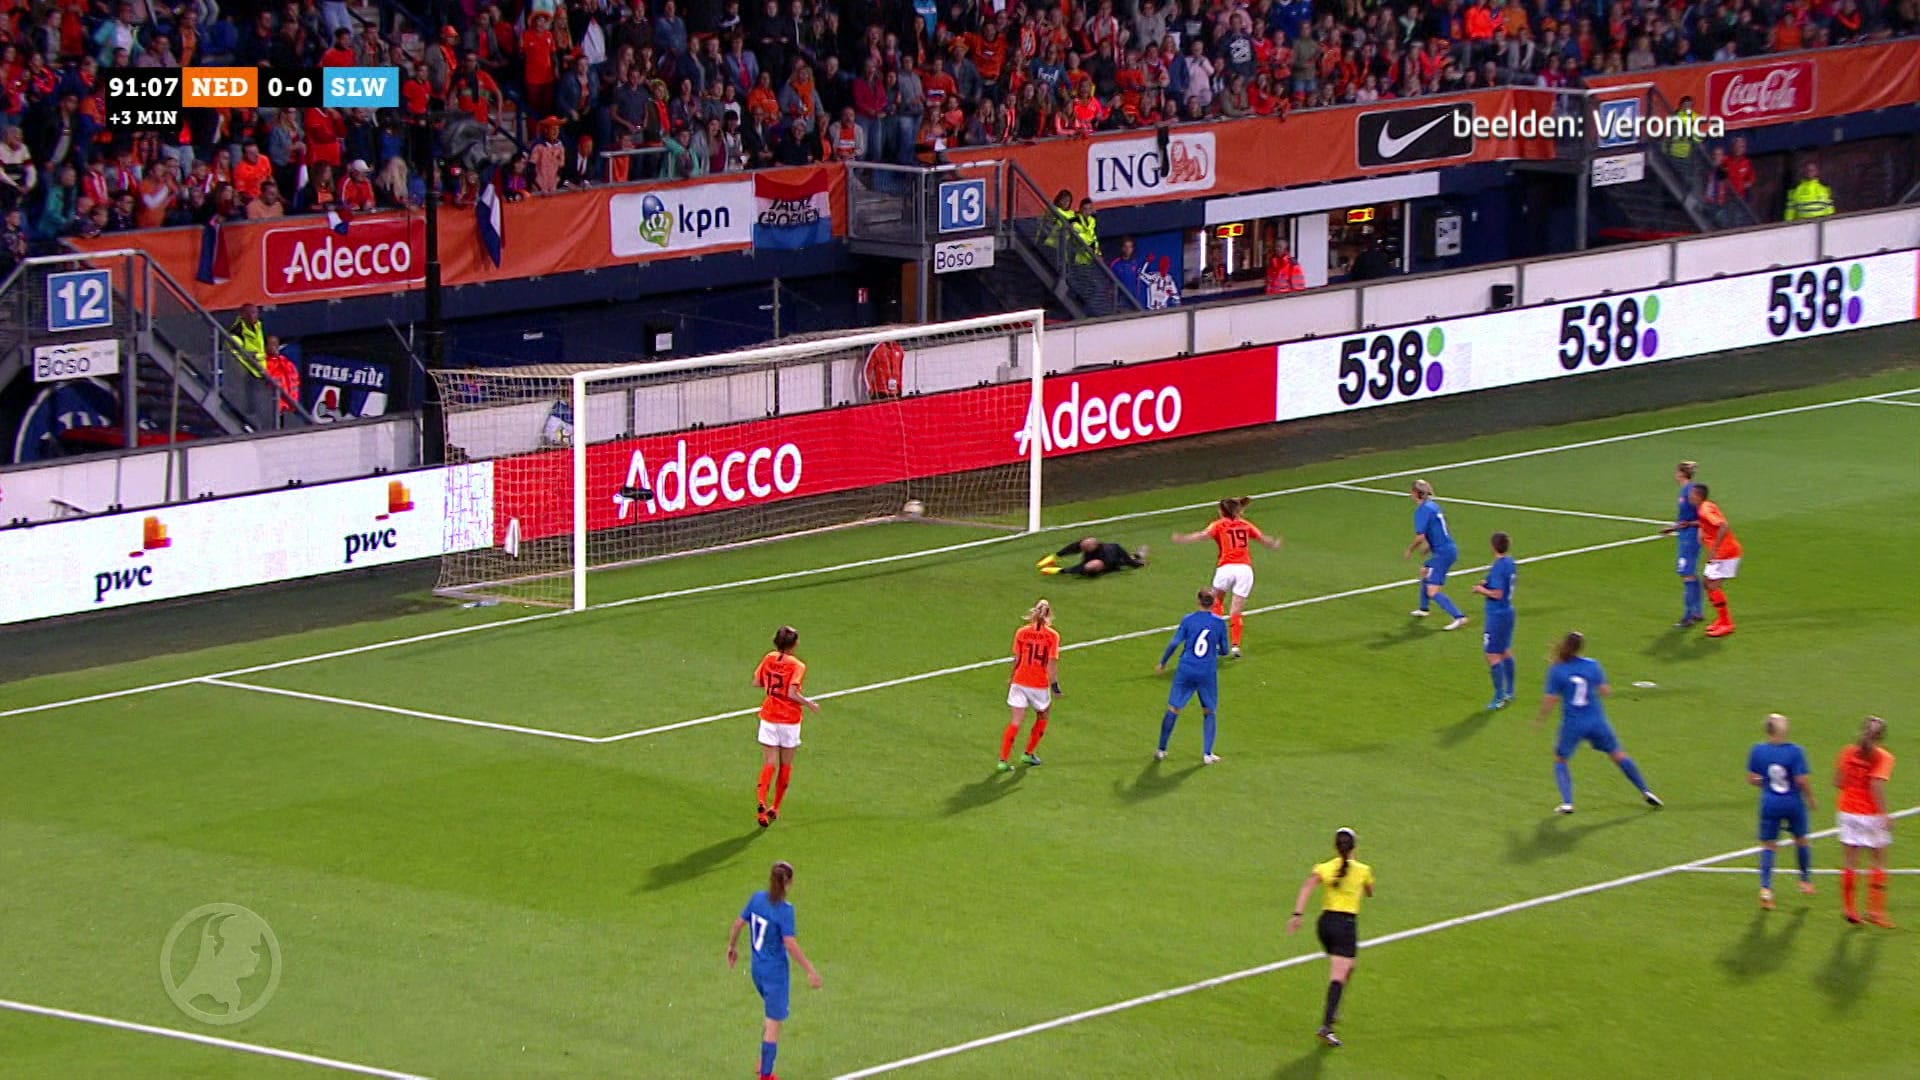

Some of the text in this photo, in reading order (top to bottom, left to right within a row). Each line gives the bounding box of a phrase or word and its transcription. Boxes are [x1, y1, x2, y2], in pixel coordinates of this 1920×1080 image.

[1095, 152, 1161, 193] ING
[678, 203, 730, 237] kpn
[946, 186, 980, 224] 13
[283, 235, 411, 284] Adecco
[57, 278, 105, 321] 12
[1767, 265, 1844, 337] 538
[1558, 296, 1640, 370] 538
[1337, 329, 1424, 406] 538
[1013, 381, 1183, 457] Adecco
[612, 439, 803, 520] Adecco
[343, 527, 398, 564] pwc
[1227, 528, 1249, 549] 19
[93, 564, 153, 603] pwc
[1026, 643, 1049, 668] 14
[1194, 629, 1211, 658] 6
[767, 672, 784, 698] 12
[751, 911, 769, 951] 17
